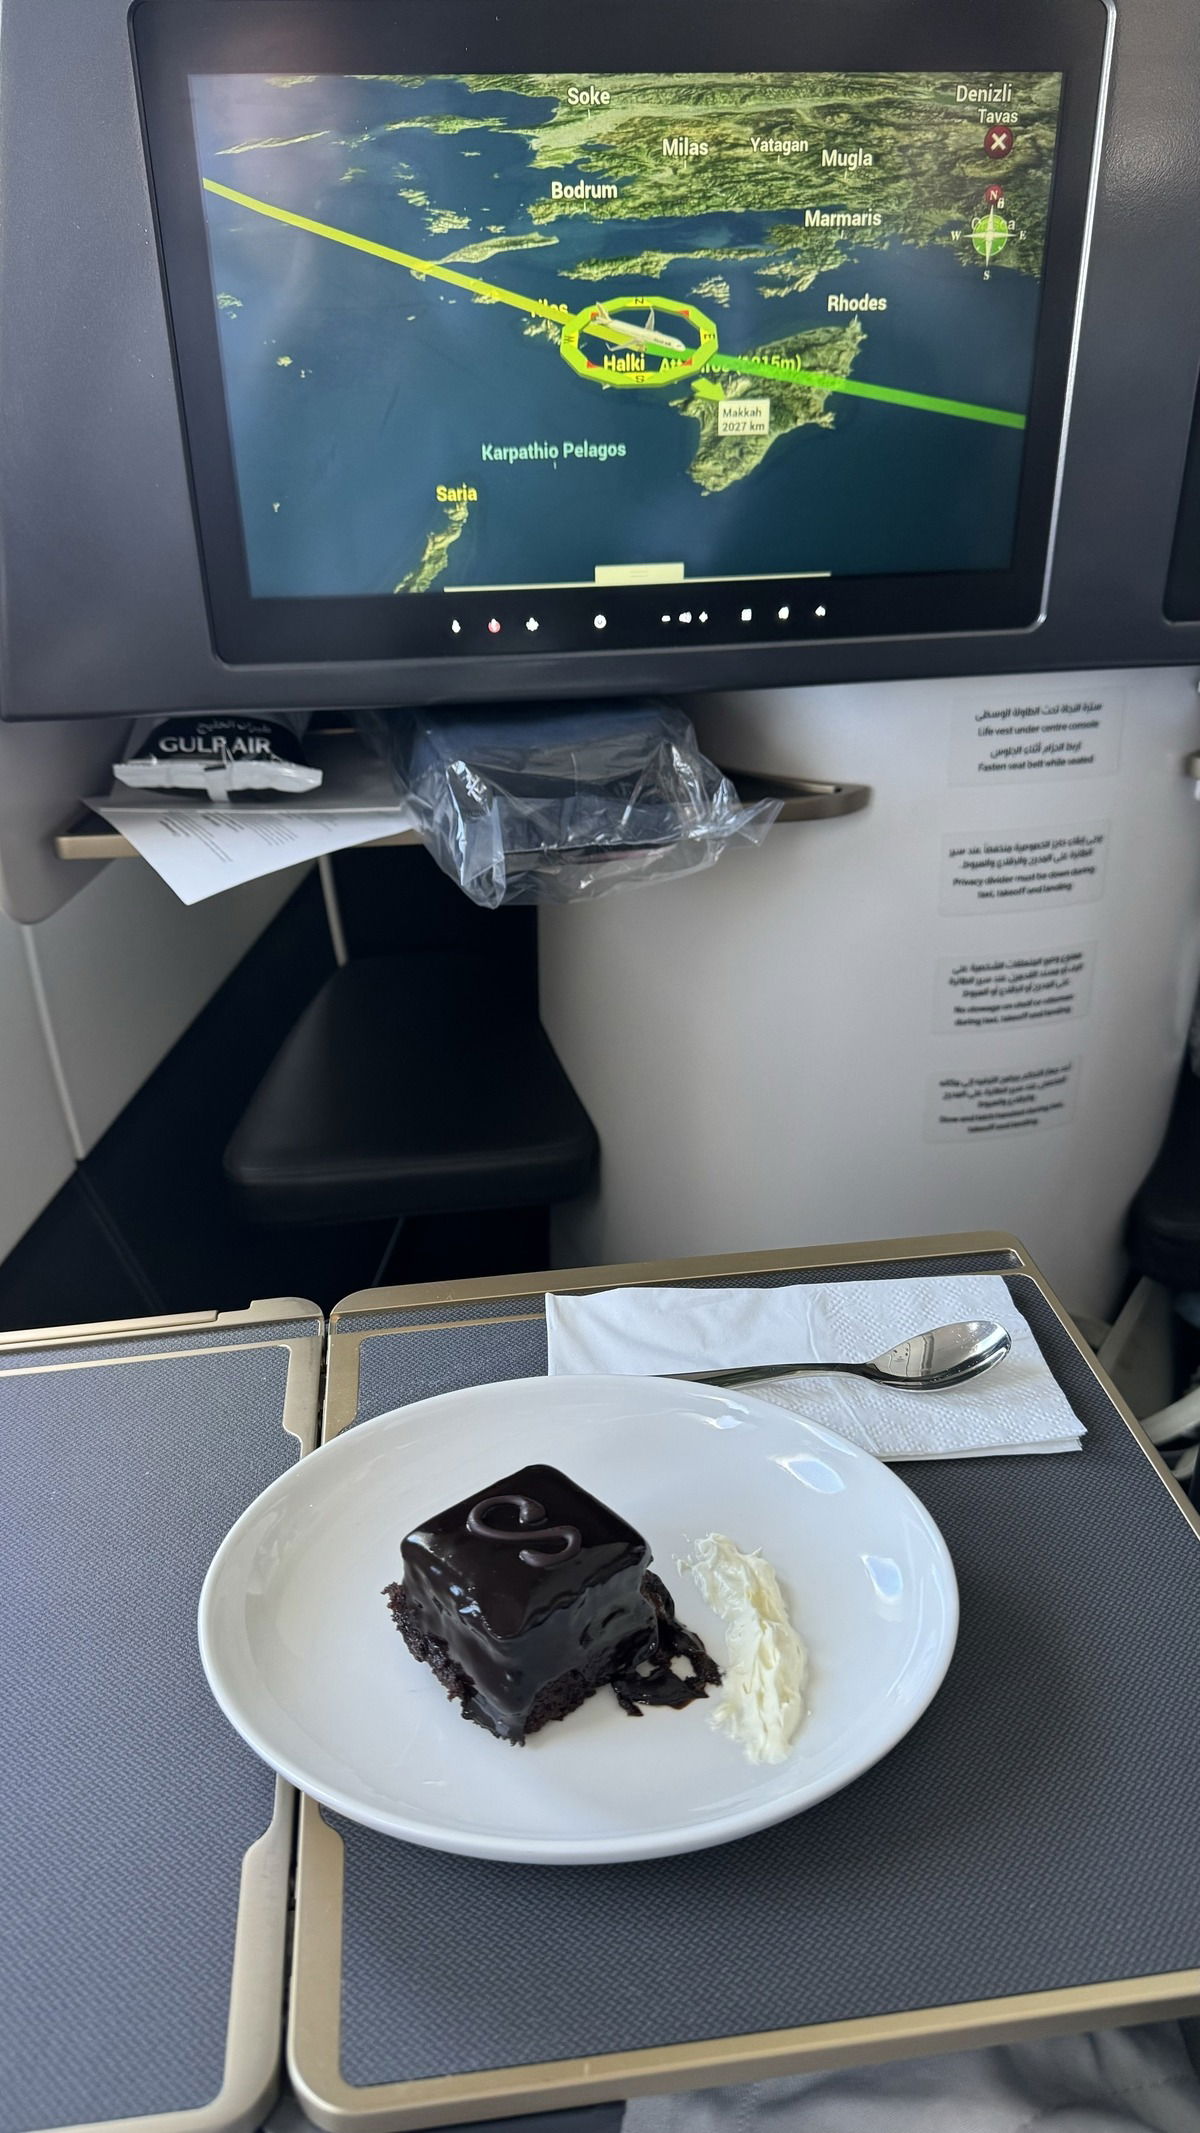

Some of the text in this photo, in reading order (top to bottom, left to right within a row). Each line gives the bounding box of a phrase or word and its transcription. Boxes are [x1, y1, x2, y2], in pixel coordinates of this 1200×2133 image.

[567, 86, 611, 105] Soke
[956, 84, 1012, 102] Denizli
[978, 108, 1018, 124] Tavas
[662, 138, 709, 156] Milas
[750, 137, 809, 156] Yatagan
[821, 148, 873, 170] Mugla
[551, 179, 618, 199] Bodrum
[989, 190, 998, 201] N
[805, 208, 882, 228] Marmaris
[951, 231, 962, 241] W
[1019, 230, 1027, 241] E
[983, 270, 991, 281] S
[827, 293, 887, 312] Rhodes
[603, 352, 645, 372] Halki
[722, 407, 763, 418] Makkah
[722, 420, 766, 432] 2027 km
[481, 438, 627, 464] Karpathio Pelagos
[436, 482, 478, 502] Saria
[978, 719, 1099, 737] Life vest under centre console
[231, 736, 271, 753] AIR
[978, 754, 1094, 772] Fasten seat belt while seated
